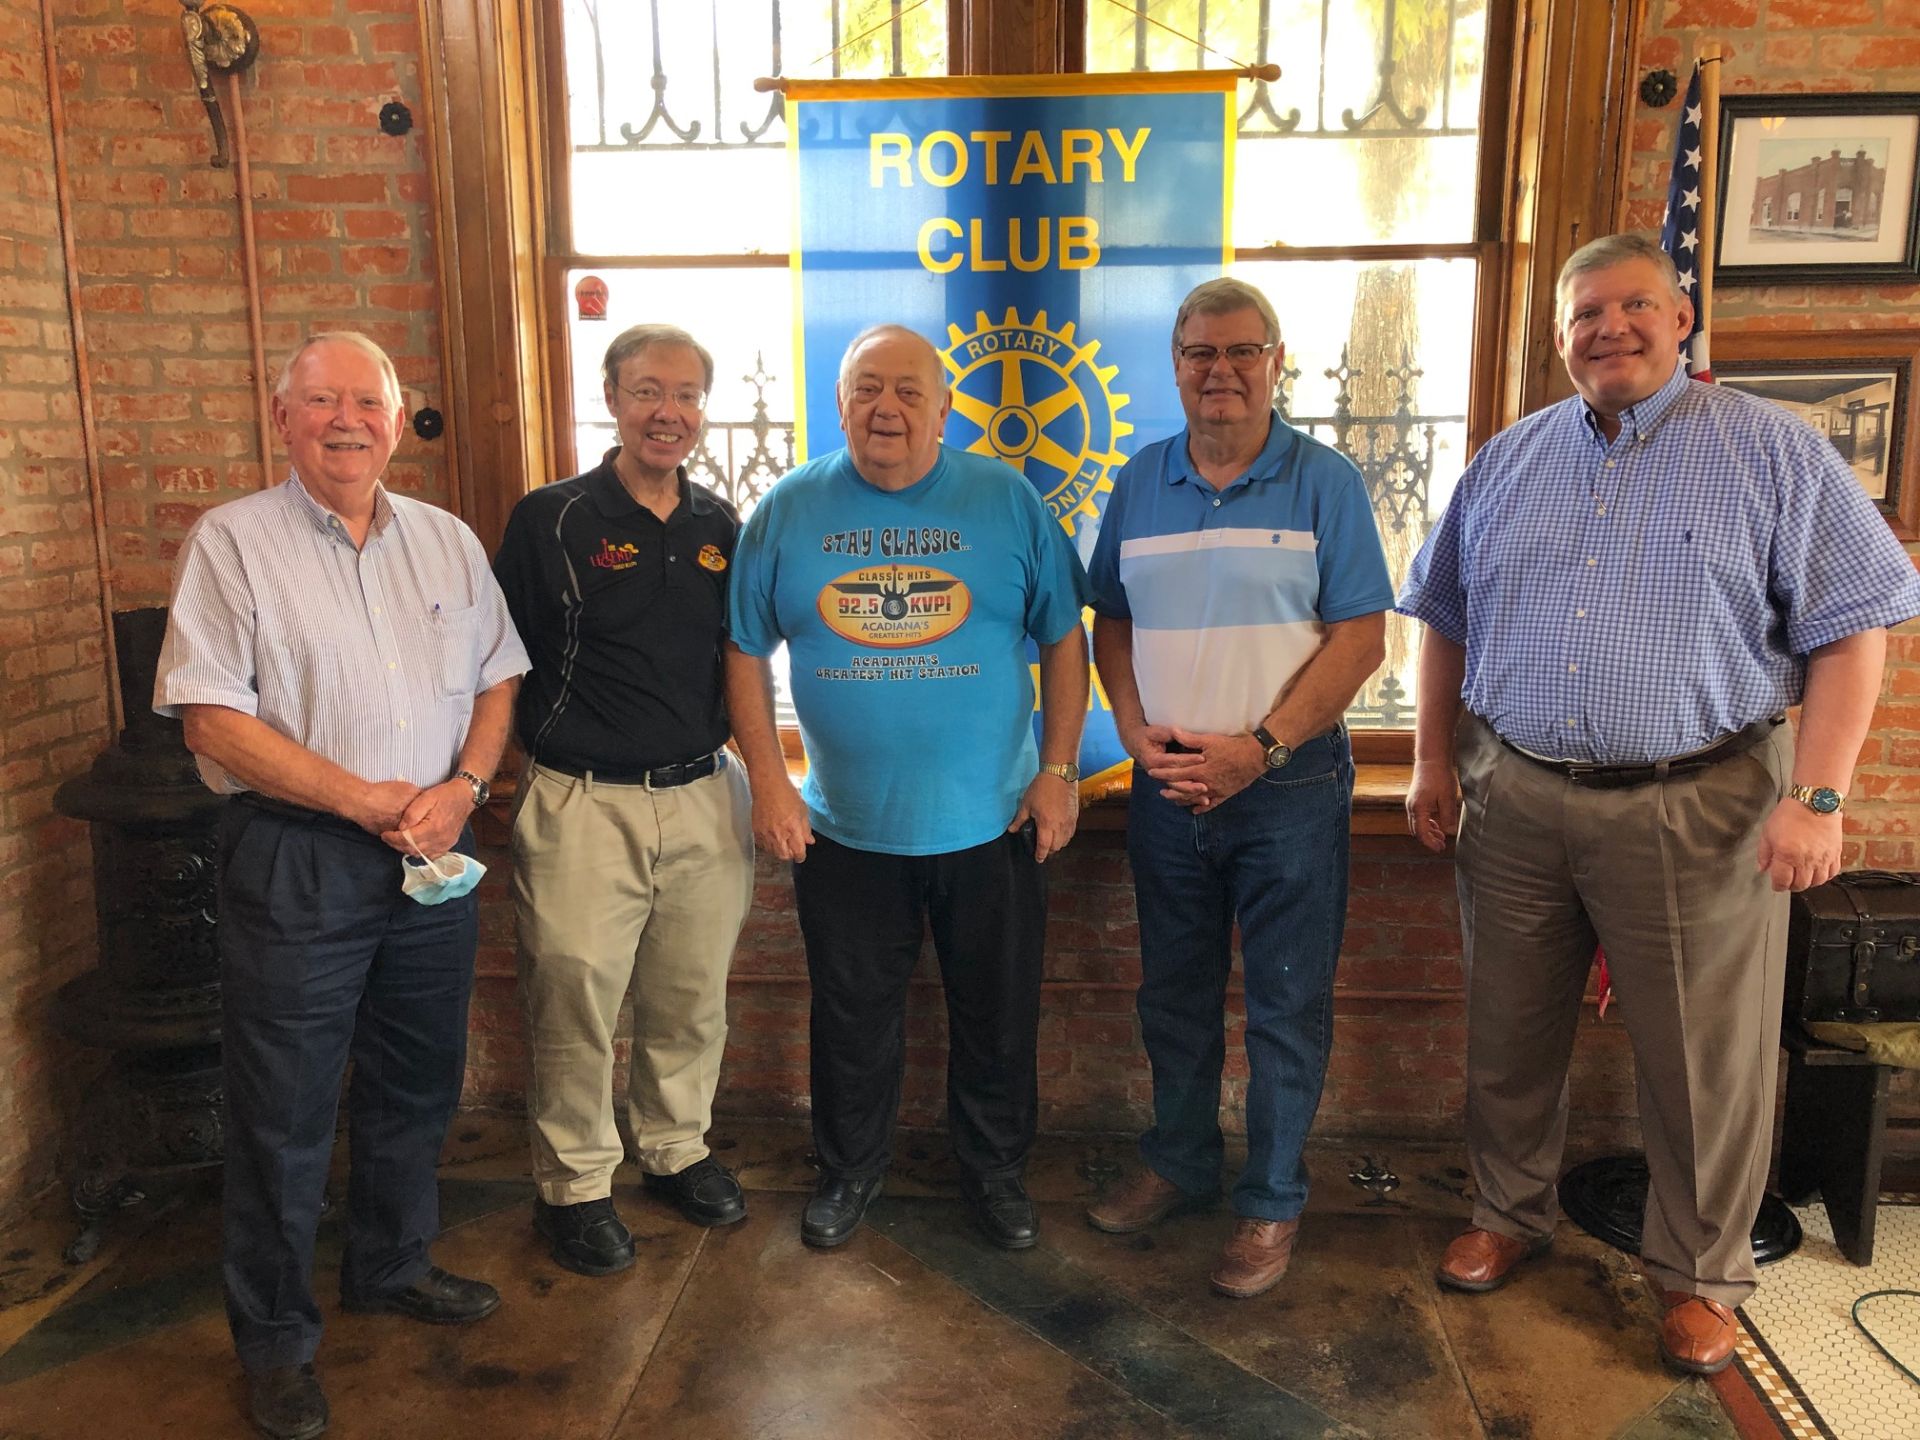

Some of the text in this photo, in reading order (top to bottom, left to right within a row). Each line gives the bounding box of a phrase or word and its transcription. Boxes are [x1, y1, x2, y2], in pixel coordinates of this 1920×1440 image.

[869, 127, 1152, 189] ROTARY
[916, 216, 1101, 274] CLUB
[966, 331, 1061, 359] ROTARY
[822, 528, 874, 556] STAY
[907, 570, 931, 580] HITS
[838, 595, 951, 614] 92.5 KVPI
[861, 621, 929, 631] ACADIANA'S
[852, 655, 939, 667] ACADIANA'S
[816, 664, 980, 680] GREATEST HIT STATION
